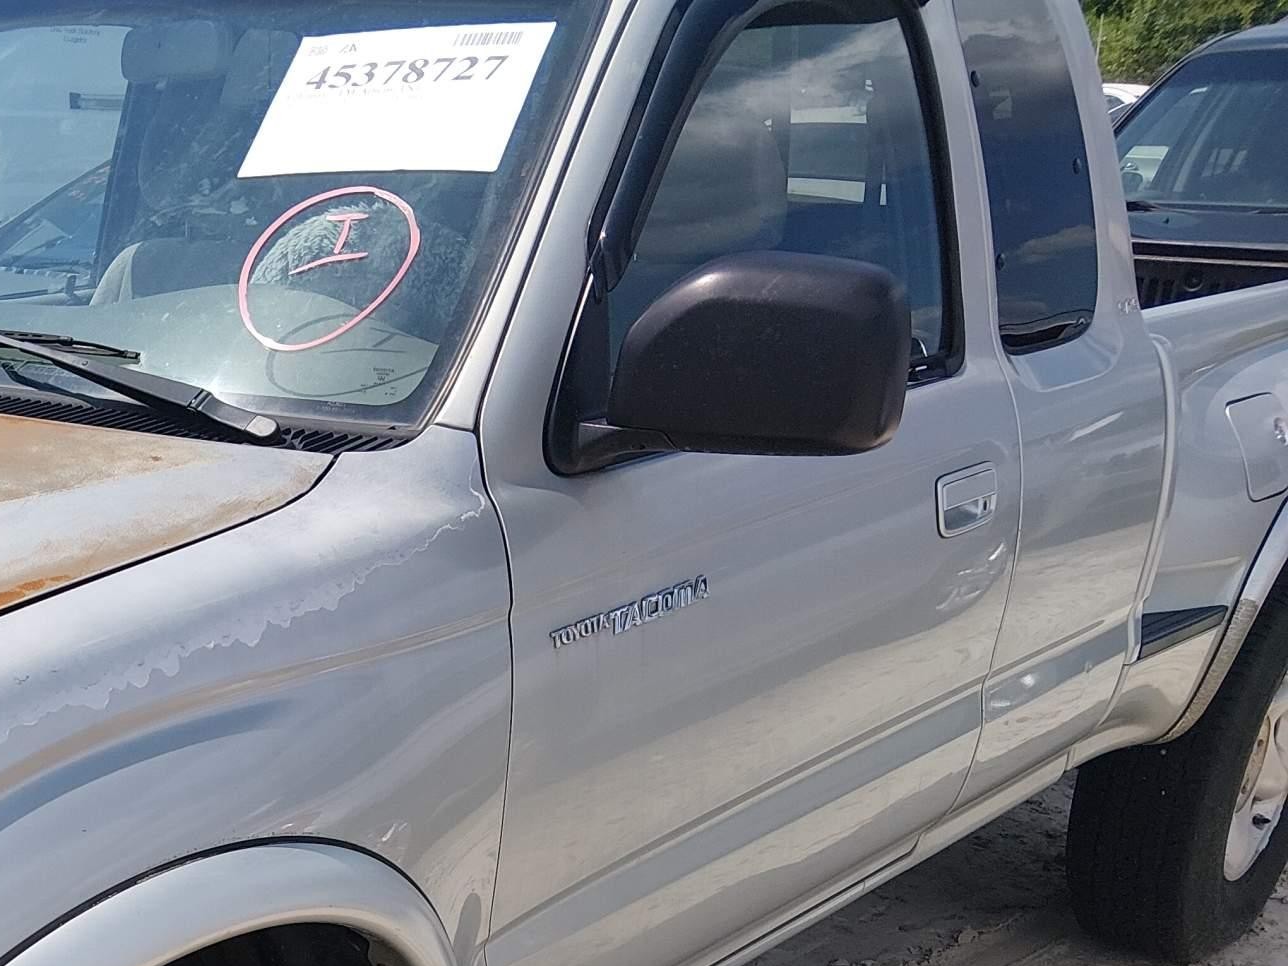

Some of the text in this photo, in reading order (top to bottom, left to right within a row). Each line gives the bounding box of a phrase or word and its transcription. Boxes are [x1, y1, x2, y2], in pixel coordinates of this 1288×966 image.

[306, 55, 510, 90] 45378727
[550, 574, 710, 649] TOYOTA TACOMA
